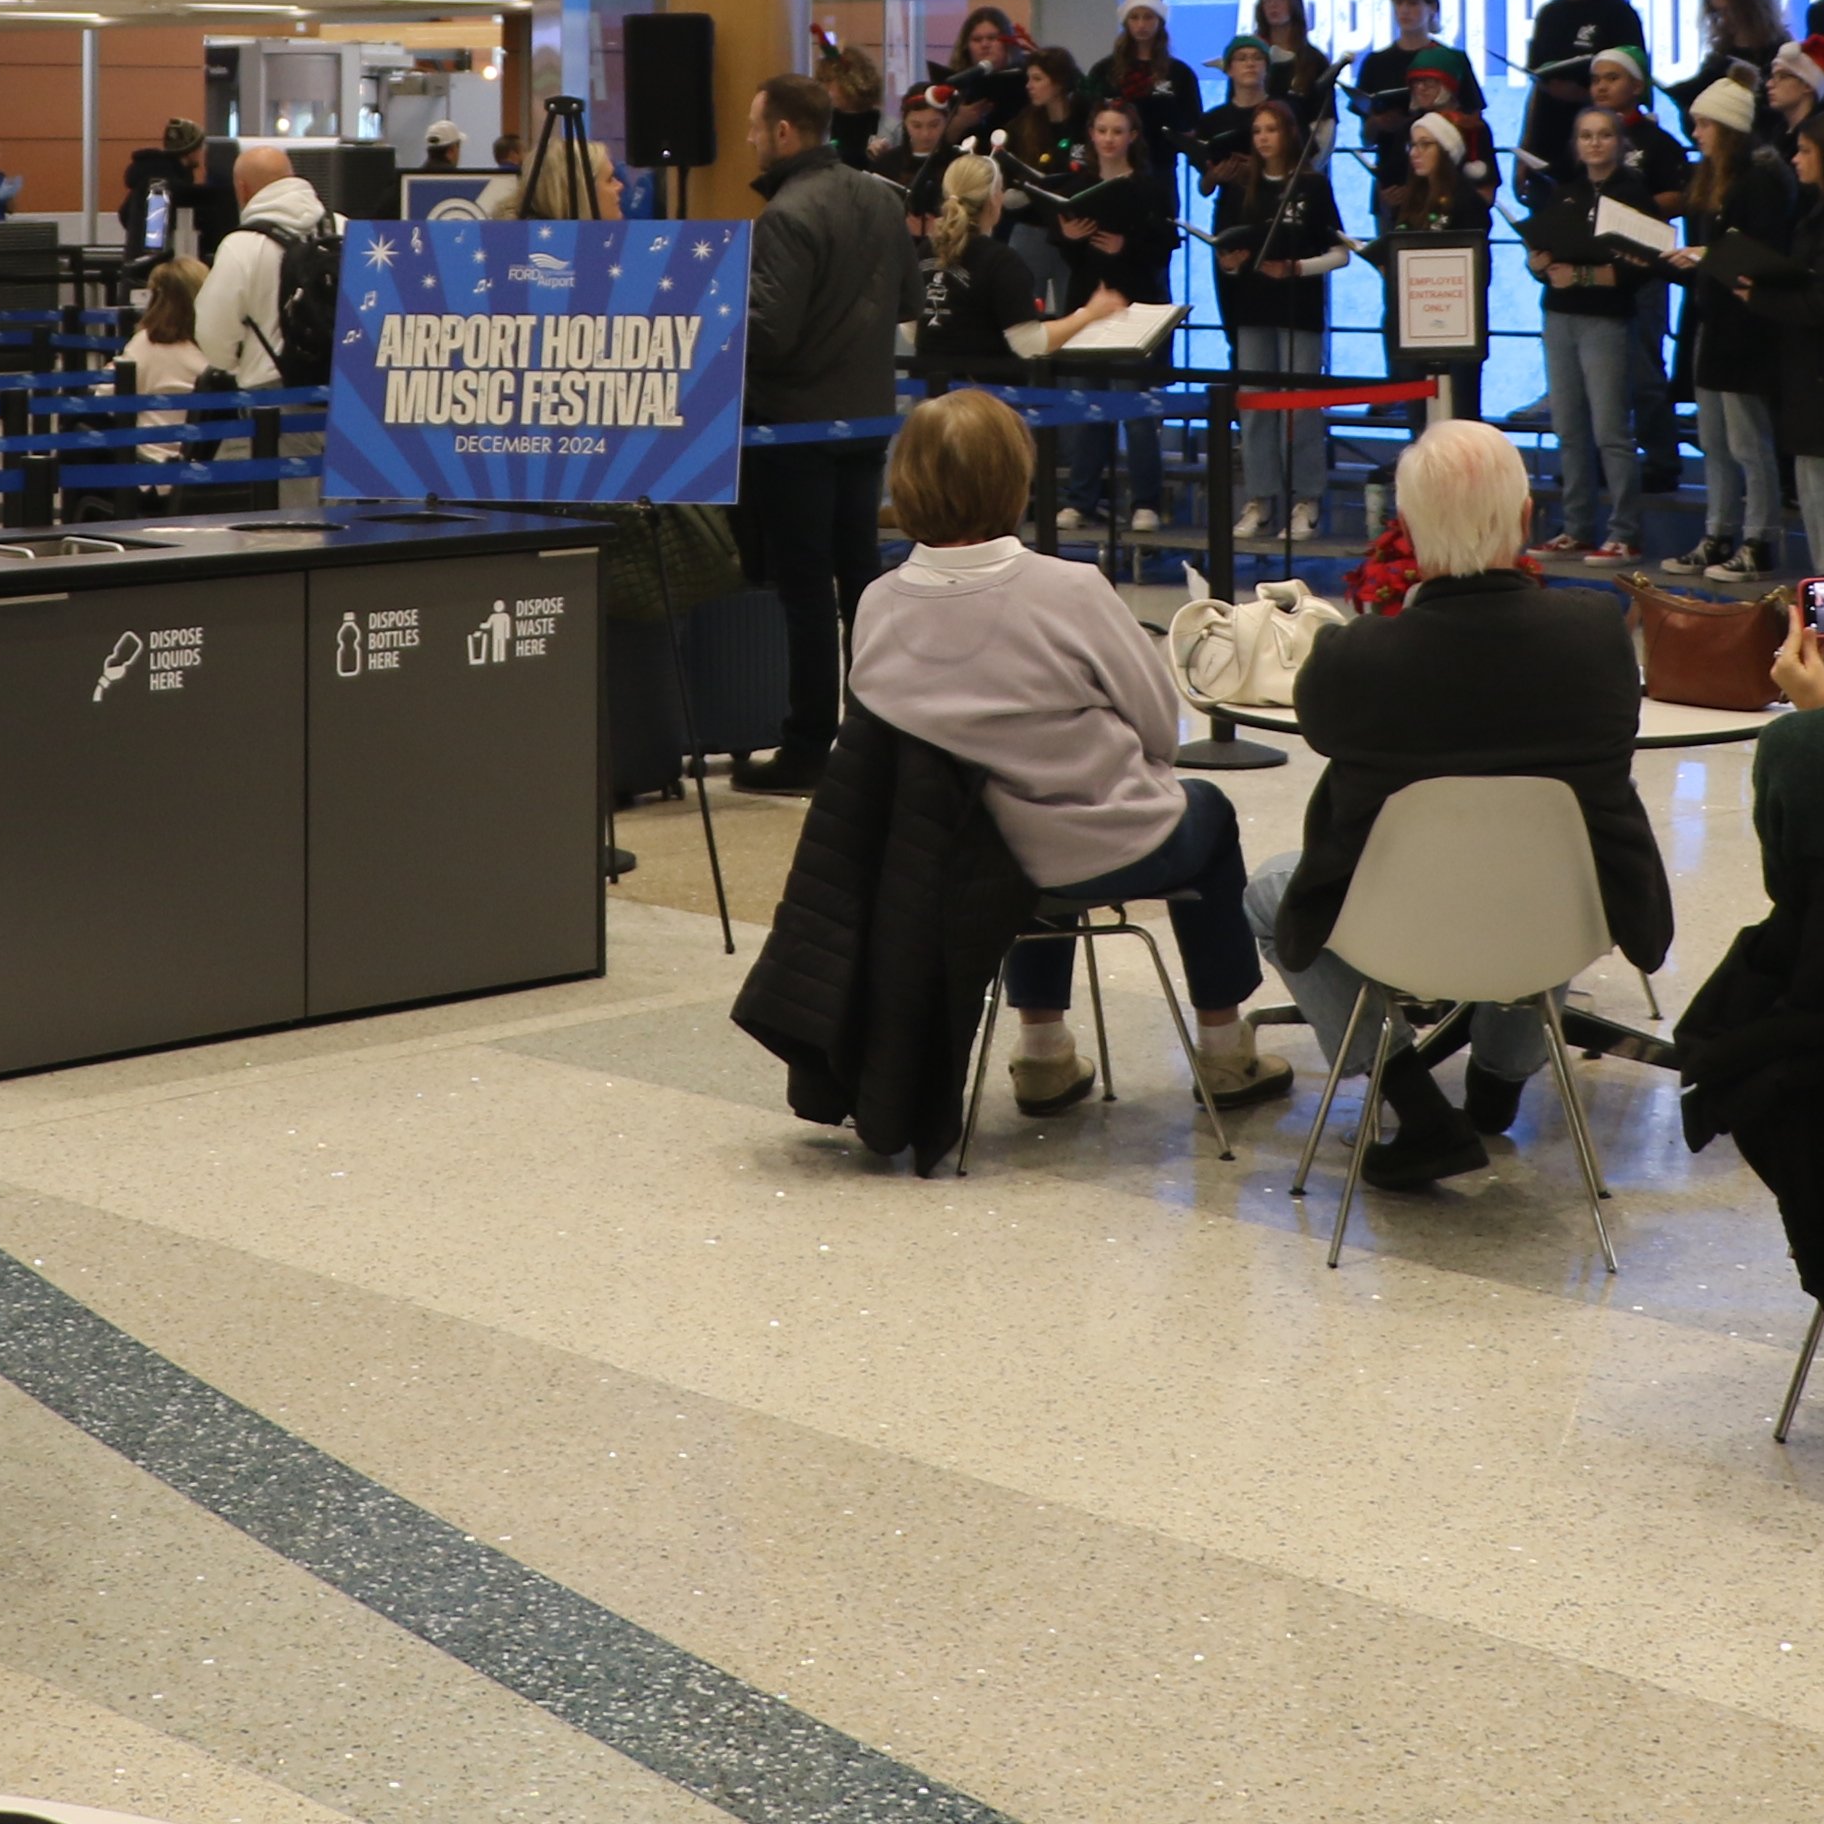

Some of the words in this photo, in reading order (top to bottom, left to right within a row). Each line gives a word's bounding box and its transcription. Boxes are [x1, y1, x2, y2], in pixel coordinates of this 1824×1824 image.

[508, 268, 540, 280] FORD
[537, 275, 575, 288] Airport
[1423, 303, 1451, 313] ONLY
[376, 314, 537, 369] AIRPORT
[541, 315, 701, 370] HOLIDAY
[384, 370, 515, 425] MUSIC
[522, 371, 684, 426] FESTIVAL
[455, 436, 552, 454] DECEMBER
[558, 436, 606, 455] 2024
[516, 597, 564, 617] DISPOSE
[368, 609, 419, 630] DISPOSE
[516, 618, 555, 637] WASTE
[150, 627, 204, 649] DISPOSE
[368, 629, 420, 651] BOTTLES
[516, 638, 546, 656] HERE
[150, 648, 201, 670] LIQUIDS
[368, 651, 400, 670] HERE
[150, 671, 184, 691] HERE
